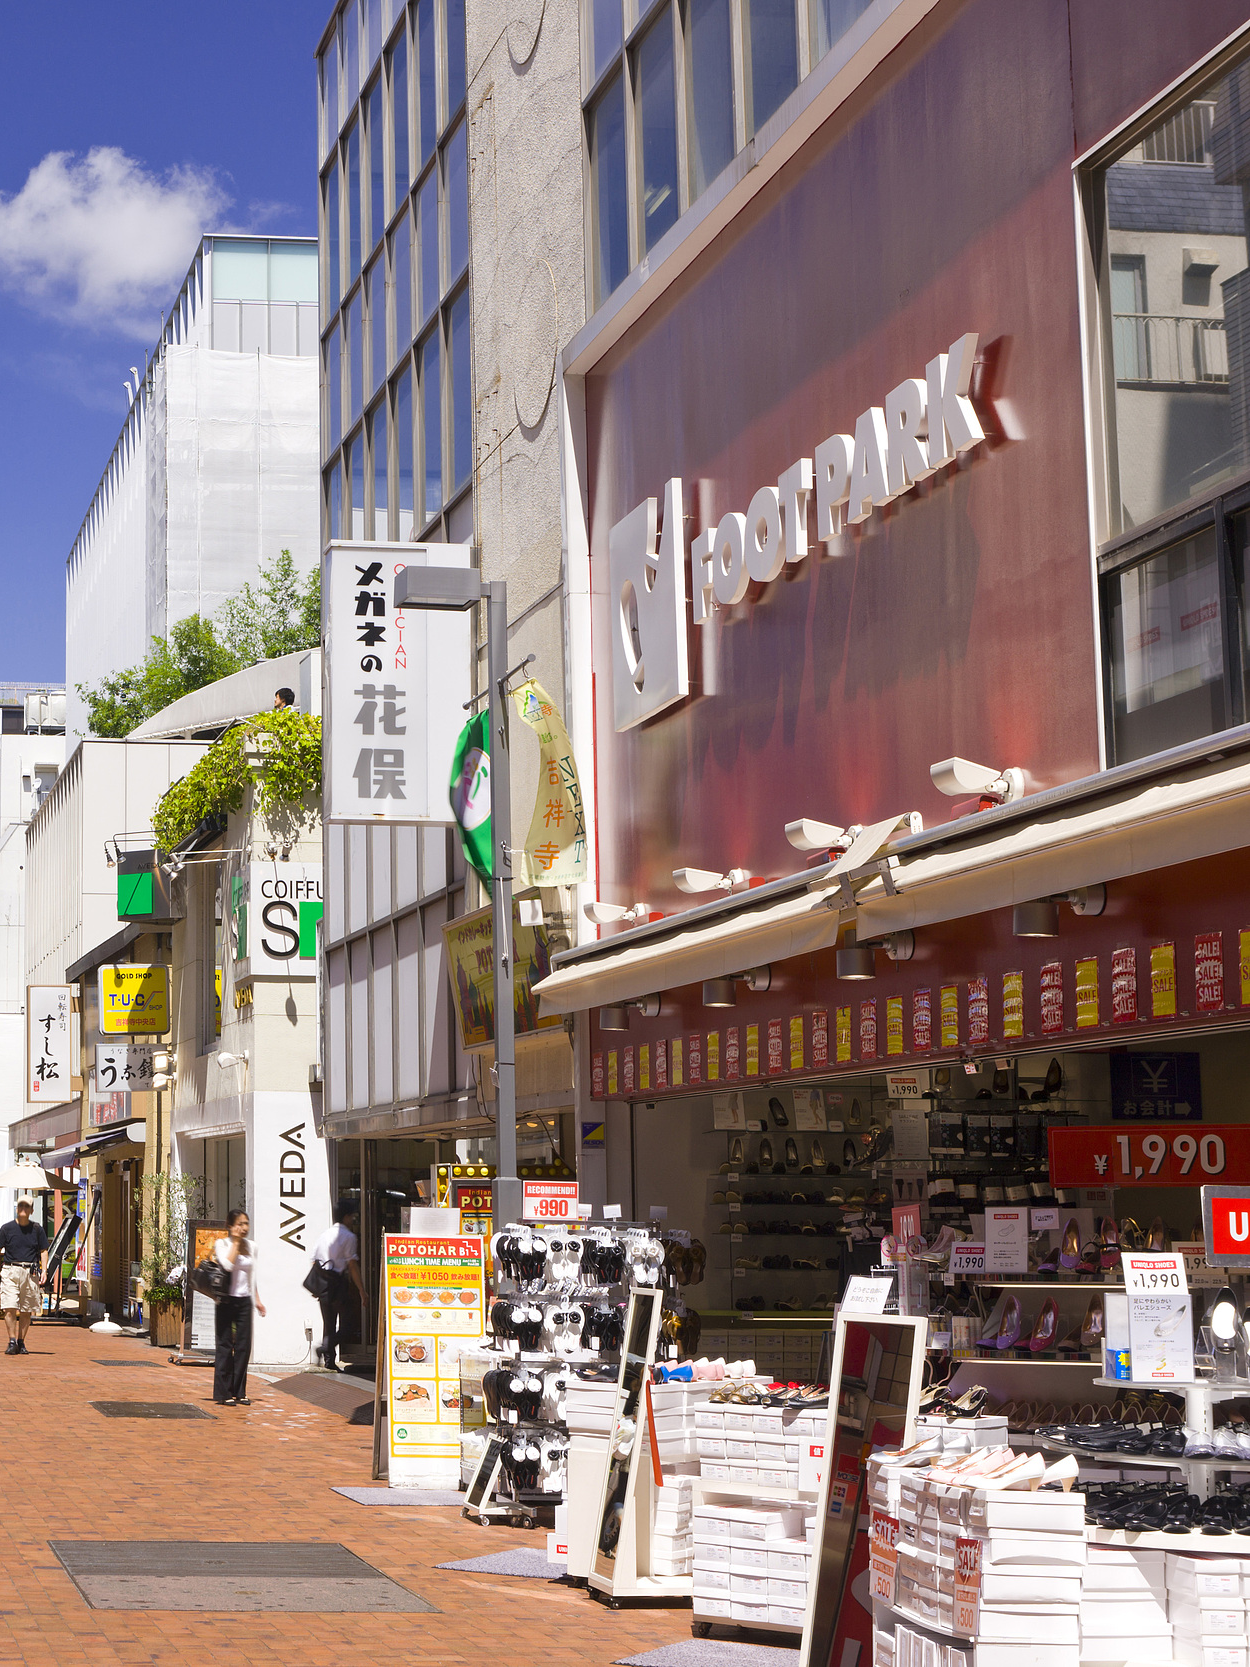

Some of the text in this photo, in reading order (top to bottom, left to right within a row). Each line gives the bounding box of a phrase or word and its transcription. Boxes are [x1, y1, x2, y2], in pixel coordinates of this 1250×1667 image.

[533, 756, 565, 871] 吉祥寺
[559, 755, 586, 864] NEXT
[1197, 941, 1220, 958] SALE!
[1197, 964, 1222, 980] SALE!
[1153, 977, 1174, 993] SALE
[1078, 989, 1097, 1002] SALE
[1197, 986, 1222, 1003] SALE!
[1114, 1000, 1135, 1015] SALE!
[35, 1014, 60, 1081] すし松
[1123, 1100, 1172, 1116] お会計
[1094, 1134, 1226, 1180] ¥1,990
[278, 1121, 306, 1252] AVEDA
[527, 1185, 575, 1195] RECOMMEND!!
[533, 1199, 569, 1217] ¥990
[389, 1244, 469, 1257] POTOHAR B1
[401, 1257, 425, 1265] LUNCH
[426, 1258, 441, 1266] TIME
[953, 1257, 984, 1269] ¥1,990
[390, 1272, 480, 1281] 食べ放題! ¥1050 飲み放題!
[1133, 1273, 1180, 1289] ¥1,990
[875, 1521, 896, 1549] SALE
[958, 1548, 979, 1573] SALE
